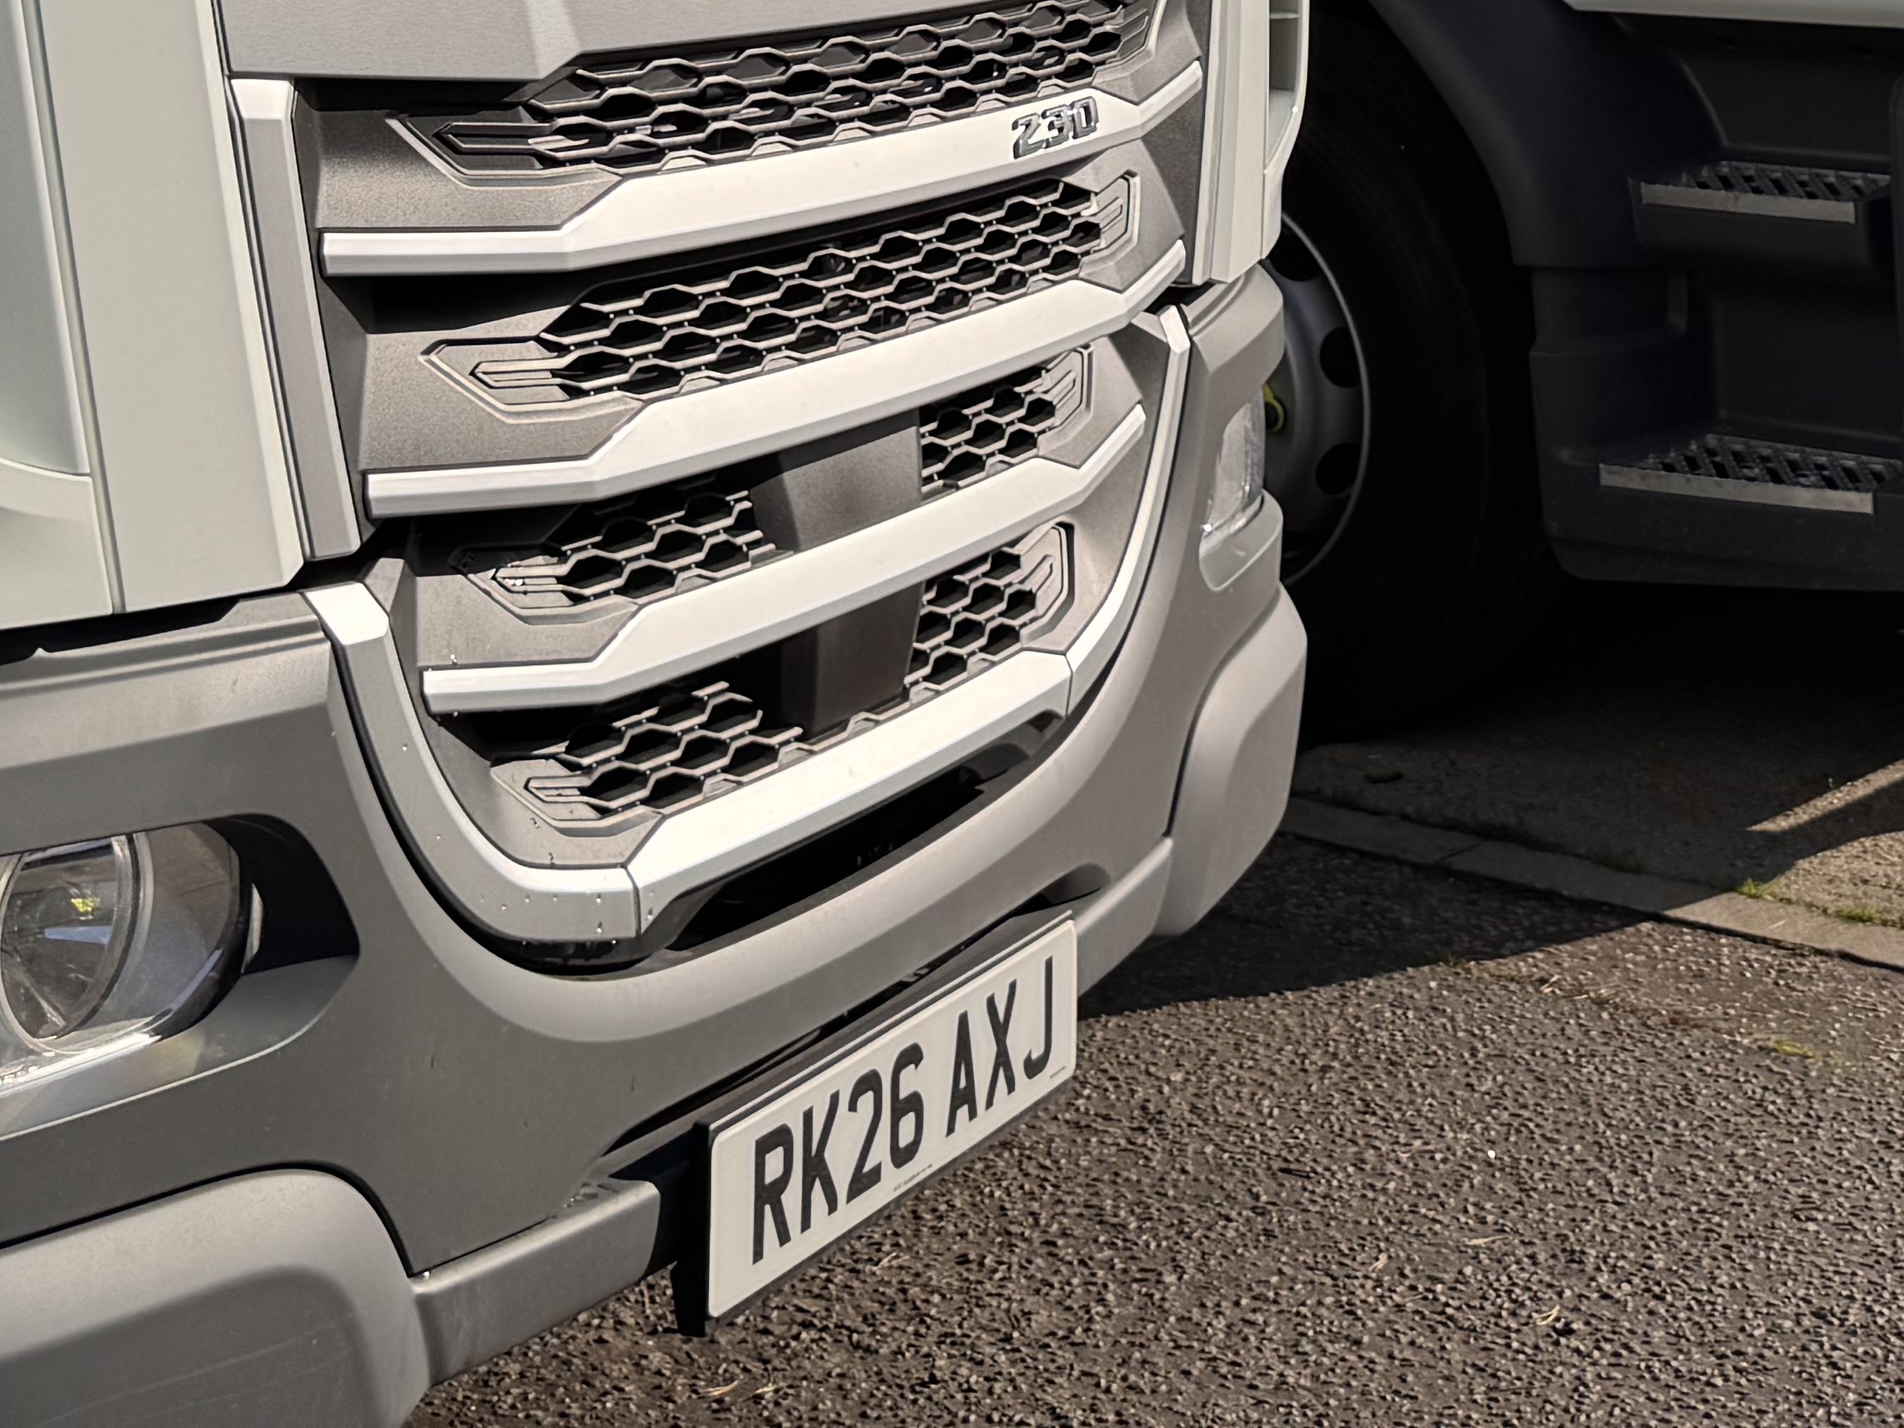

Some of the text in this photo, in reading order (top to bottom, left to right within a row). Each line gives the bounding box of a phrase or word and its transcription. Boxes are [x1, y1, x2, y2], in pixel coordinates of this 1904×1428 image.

[1011, 95, 1099, 159] 230
[752, 956, 1053, 1265] RK26 AXJ
